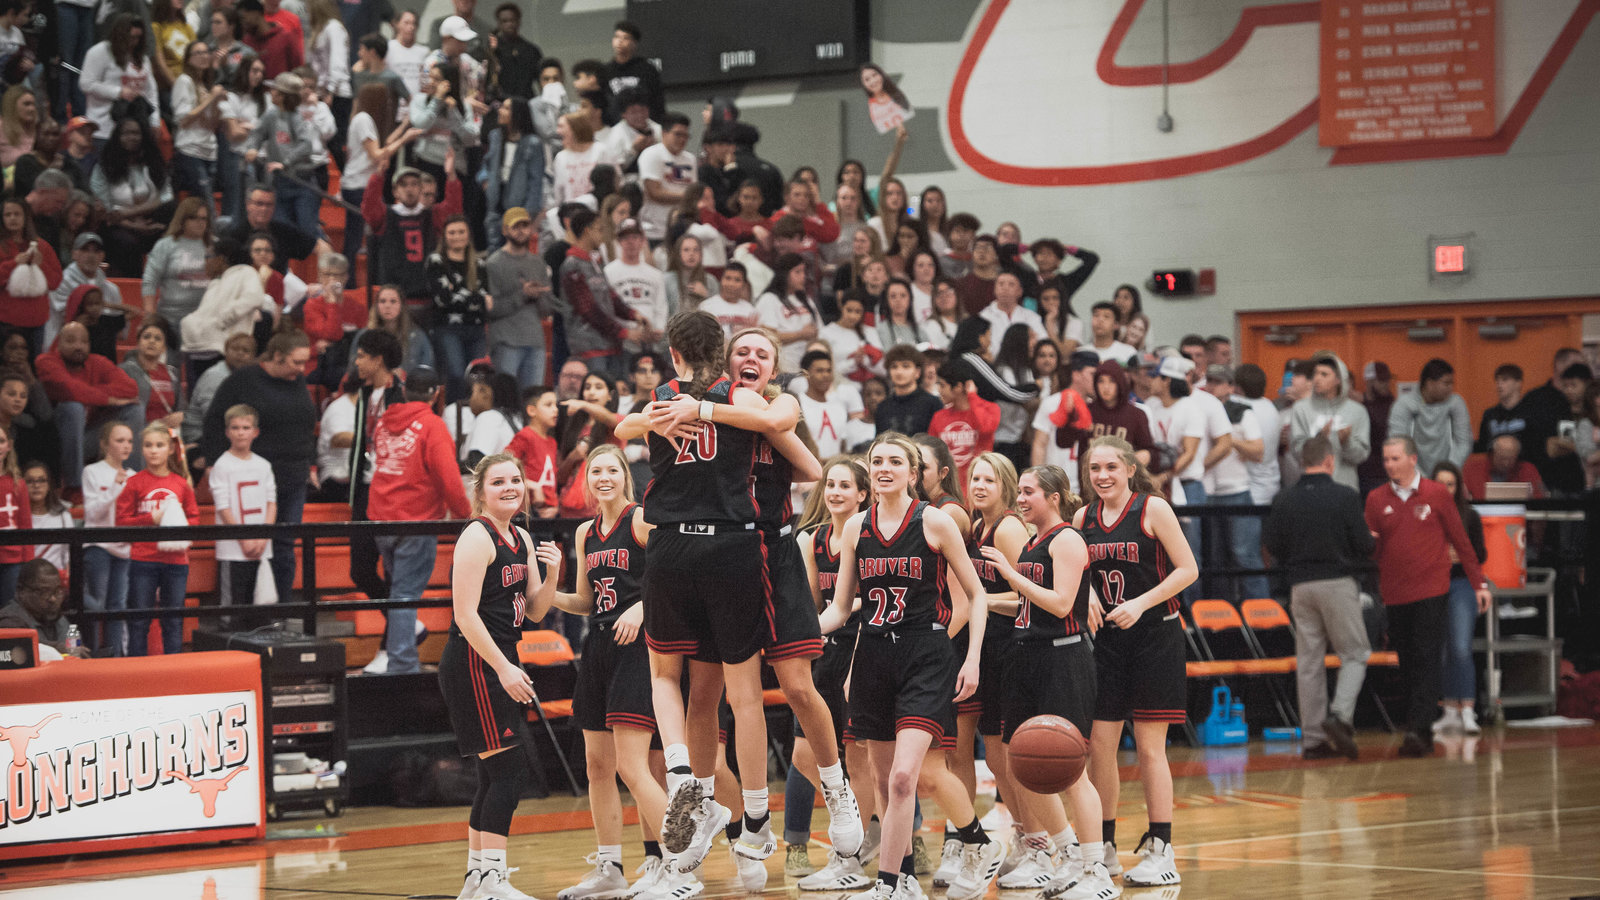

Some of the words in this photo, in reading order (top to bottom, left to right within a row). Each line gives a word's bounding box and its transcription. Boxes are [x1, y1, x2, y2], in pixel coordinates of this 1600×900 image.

[720, 50, 756, 72] game
[404, 229, 424, 262] 9
[818, 409, 837, 440] A
[674, 420, 718, 465] 20
[586, 548, 630, 575] RUVER
[859, 556, 923, 581] GRUVER
[1089, 541, 1140, 564] RUVER
[593, 576, 618, 614] 25
[1097, 569, 1126, 606] 12
[868, 586, 908, 627] 23
